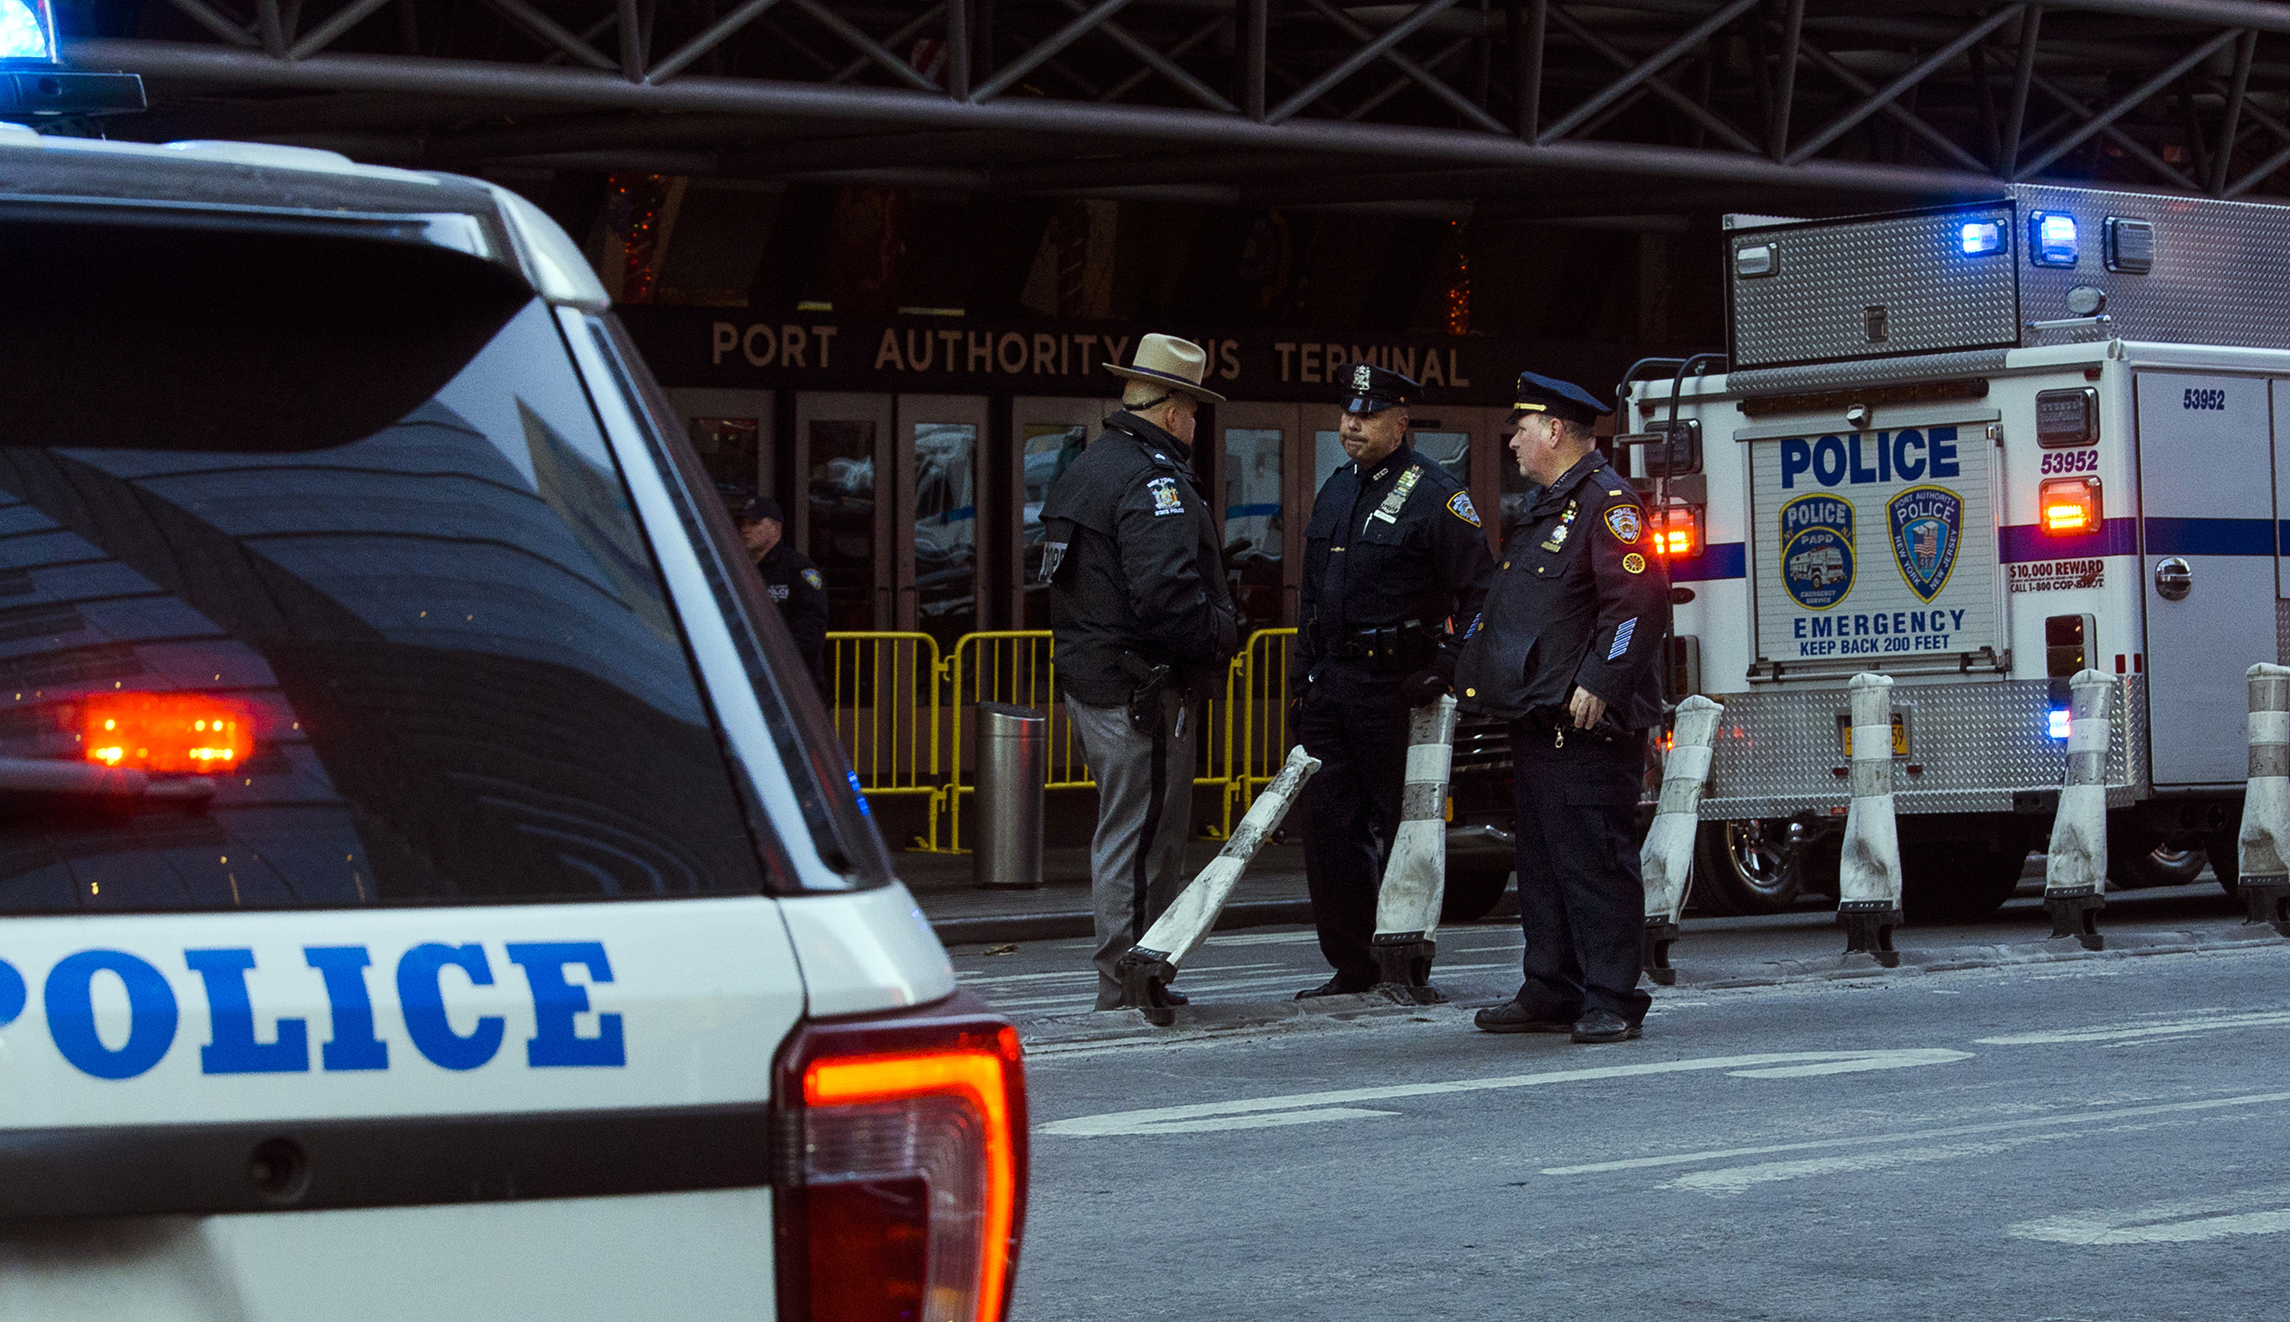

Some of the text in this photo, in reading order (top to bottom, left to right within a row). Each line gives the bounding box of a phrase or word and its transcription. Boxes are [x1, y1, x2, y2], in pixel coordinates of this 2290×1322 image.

[713, 322, 1469, 387] PORT AUTHORITY US TERMINAL
[2183, 388, 2225, 410] 53952
[1780, 426, 1960, 489] POLICE
[2040, 449, 2098, 475] 53952
[1894, 491, 1956, 510] PORT AUTHORITY
[1787, 502, 1846, 528] POLICE
[1896, 501, 1955, 525] POLICE
[1784, 528, 1794, 541] NY
[1801, 534, 1834, 545] PAPD
[1894, 535, 1921, 586] NEW YORK
[1929, 529, 1958, 591] NEW JERSEY
[2009, 563, 2053, 578] $10,000
[2055, 559, 2104, 576] REWARD
[2010, 583, 2027, 593] CALL
[2028, 582, 2051, 591] 1-800
[1794, 609, 1965, 639] EMERGENCY
[1800, 634, 1950, 656] KEEP BACK 200 FEET
